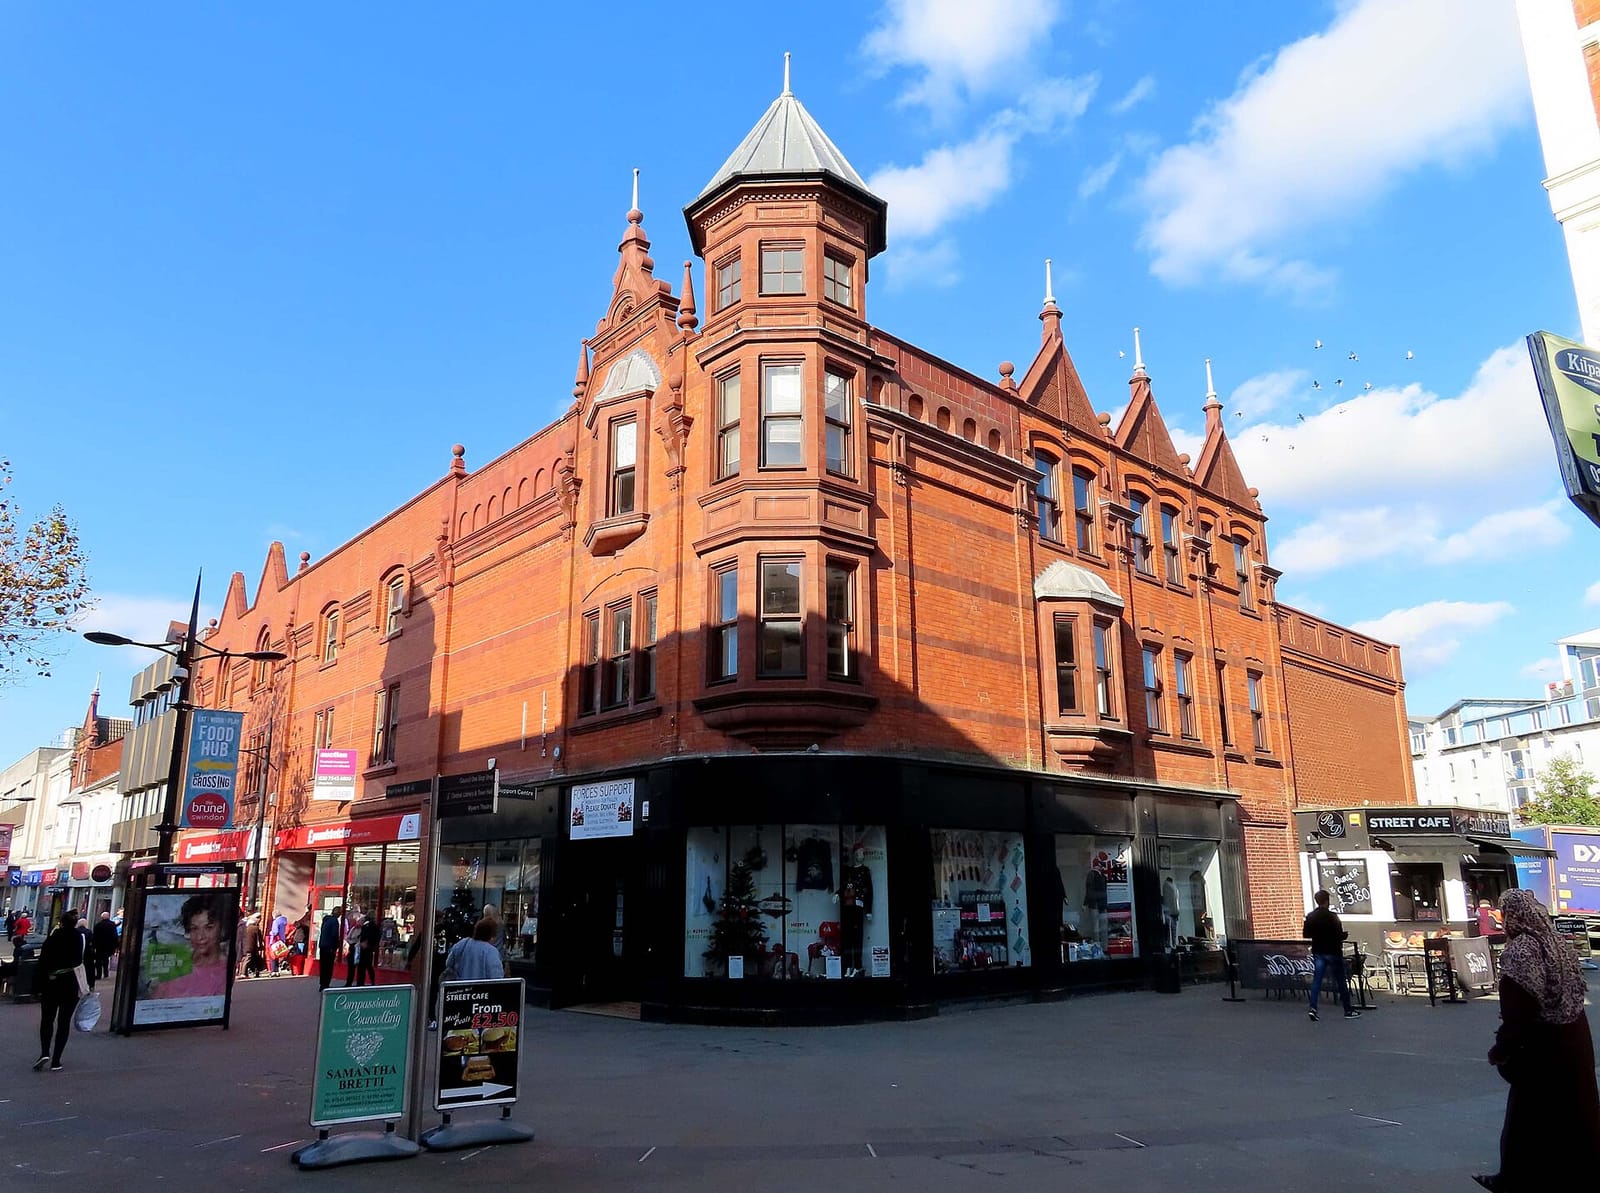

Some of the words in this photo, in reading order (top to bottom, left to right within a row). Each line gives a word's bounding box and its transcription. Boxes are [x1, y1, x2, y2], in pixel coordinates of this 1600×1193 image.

[199, 725, 234, 741] FOOD
[201, 741, 229, 756] HUB
[193, 774, 230, 788] CROSSING
[517, 788, 534, 797] Centre
[573, 786, 598, 801] FORCES
[599, 782, 633, 797] SUPPORT
[192, 802, 226, 814] brunel
[1369, 817, 1416, 829] STREET
[1417, 816, 1451, 828] CAFE
[1337, 883, 1359, 894] CHIPS
[334, 993, 400, 1011] Compassionate
[446, 993, 470, 1002] STREET
[471, 992, 489, 1000] CAFE
[472, 1003, 502, 1014] From
[347, 1009, 401, 1027] Counselling
[472, 1011, 518, 1029] £2.50
[326, 1065, 397, 1080] SAMANTHA
